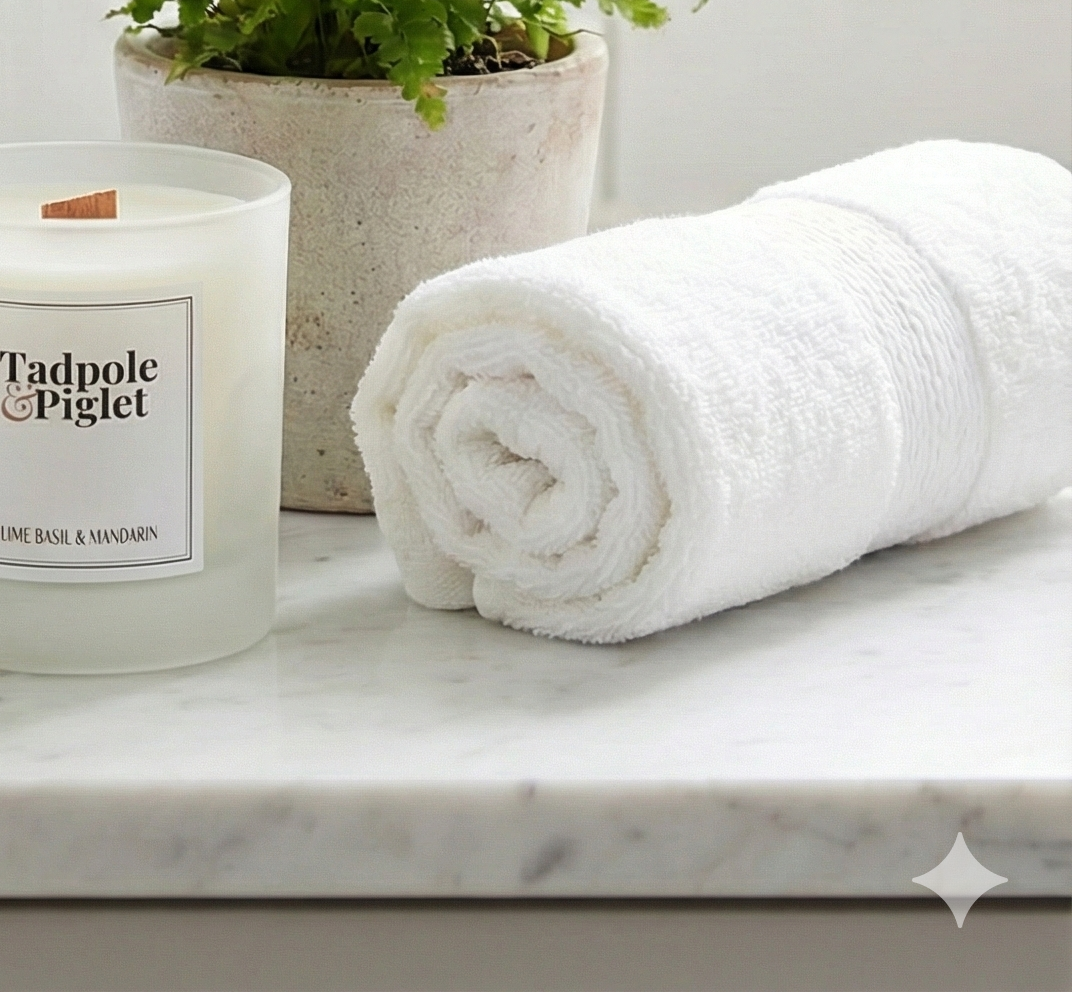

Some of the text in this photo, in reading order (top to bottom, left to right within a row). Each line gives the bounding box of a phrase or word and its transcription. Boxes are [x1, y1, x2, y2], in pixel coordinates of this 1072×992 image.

[0, 349, 159, 393] Tadpole
[34, 387, 149, 428] Piglet
[0, 525, 158, 546] LIME BASIL & MANDARIN
